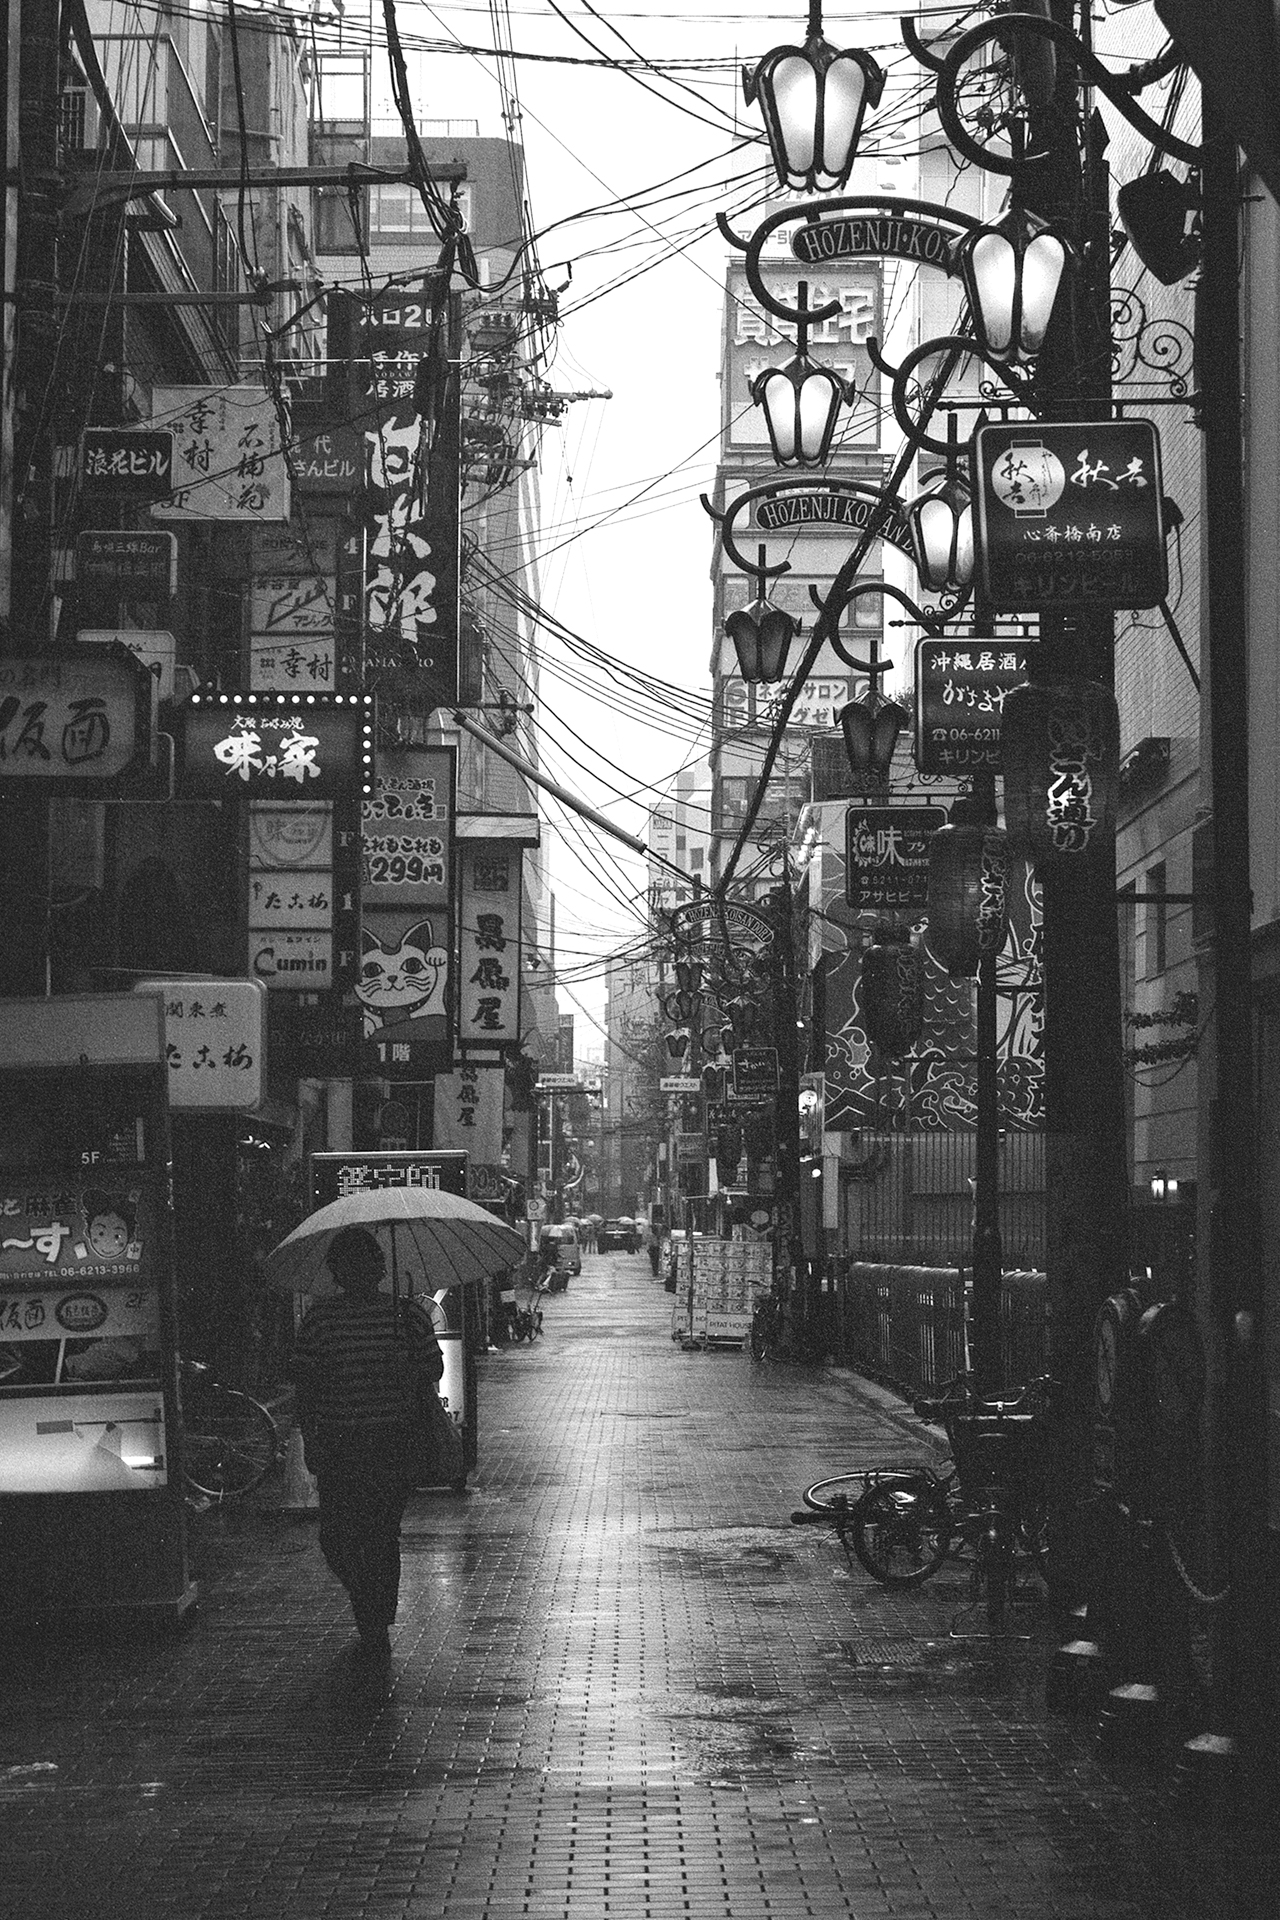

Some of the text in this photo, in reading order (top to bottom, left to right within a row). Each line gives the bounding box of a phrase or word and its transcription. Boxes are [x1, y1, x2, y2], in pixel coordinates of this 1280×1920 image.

[737, 229, 792, 245] アト引
[85, 447, 171, 477] 浪花ビル
[1023, 523, 1122, 543] 心斎橋南店
[280, 648, 334, 682] 幸村
[931, 651, 1027, 673] 沖縄居酒
[758, 683, 847, 701] ネイサロン
[213, 730, 322, 784] 味乃家
[371, 855, 443, 883] 299円
[253, 946, 327, 977] Cumin
[377, 1042, 411, 1062] 1階
[81, 1151, 100, 1165] 5F
